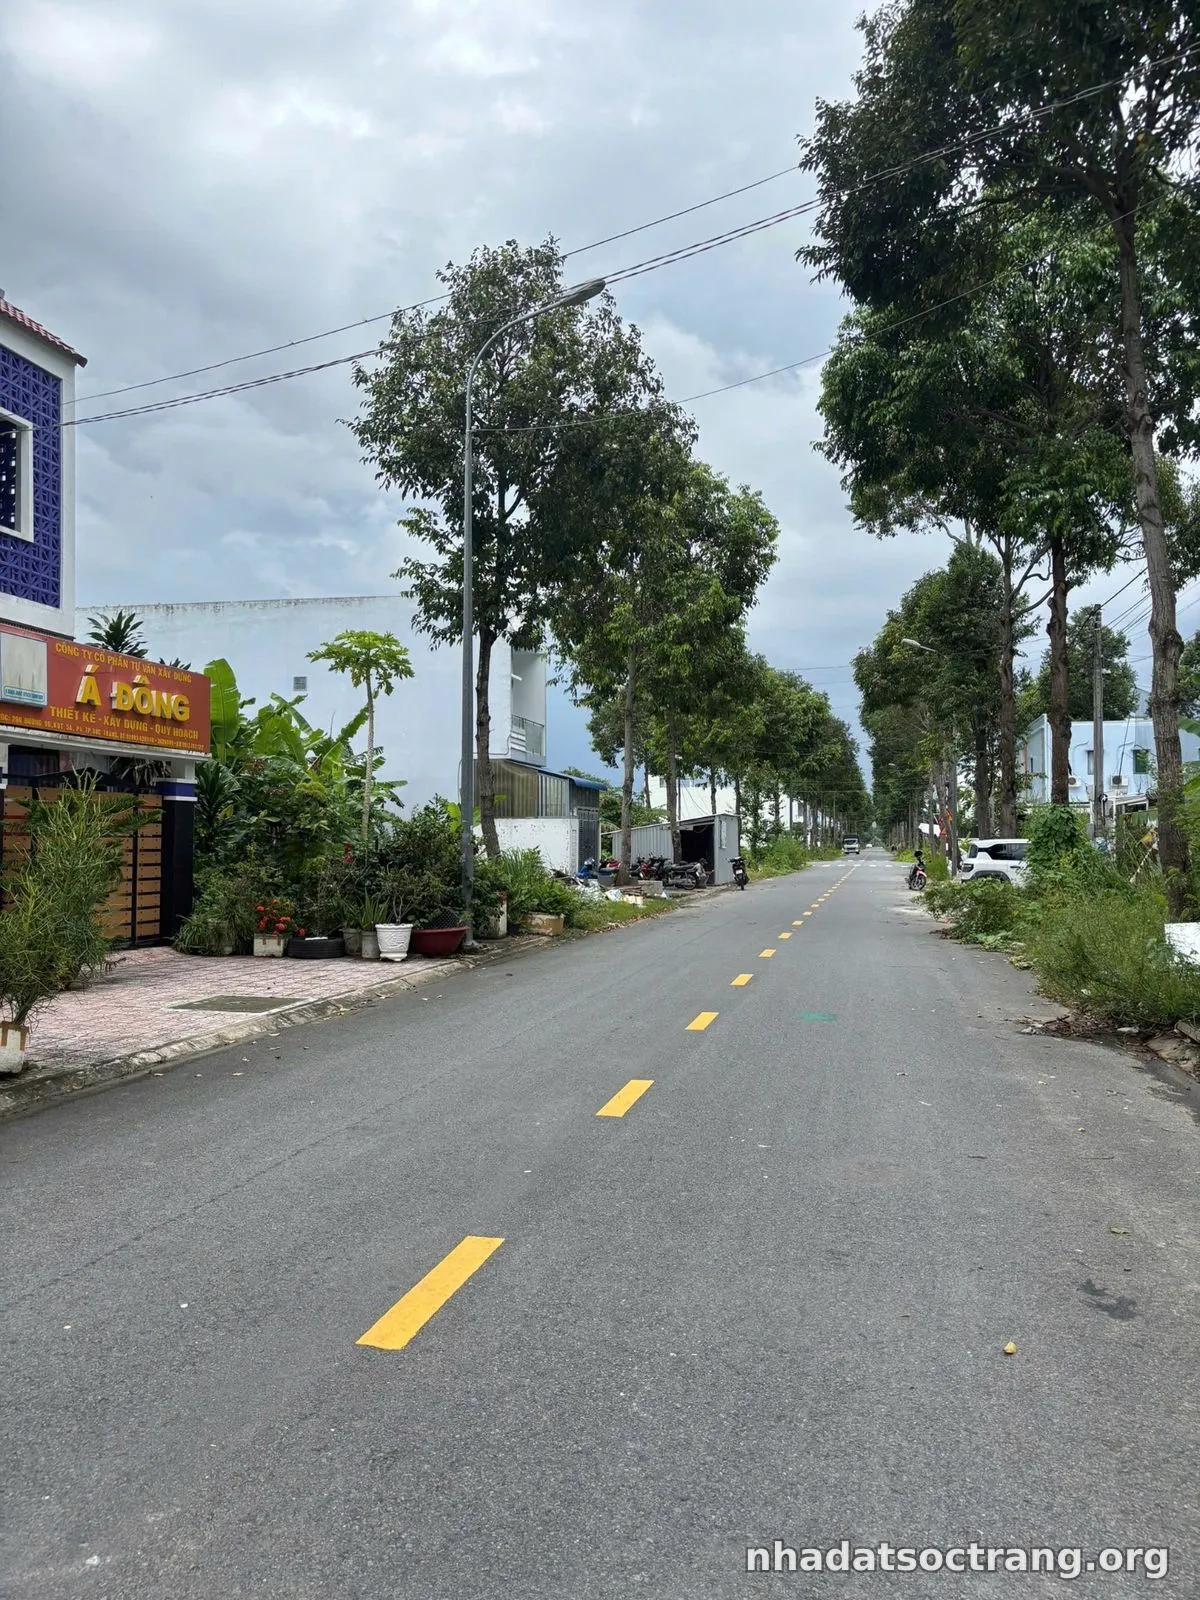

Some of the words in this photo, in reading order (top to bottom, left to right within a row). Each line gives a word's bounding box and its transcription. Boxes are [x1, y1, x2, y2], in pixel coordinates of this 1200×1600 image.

[55, 642, 79, 657] CÔNG
[82, 648, 93, 660] TY
[157, 666, 171, 679] XÂY
[75, 664, 102, 706] Á
[110, 674, 190, 722] ĐÔNG
[50, 706, 79, 721] THIẾT
[82, 711, 96, 724] KẾ
[103, 714, 121, 727] XÂY
[155, 723, 172, 736] QUY
[173, 728, 199, 740] HOẠCH
